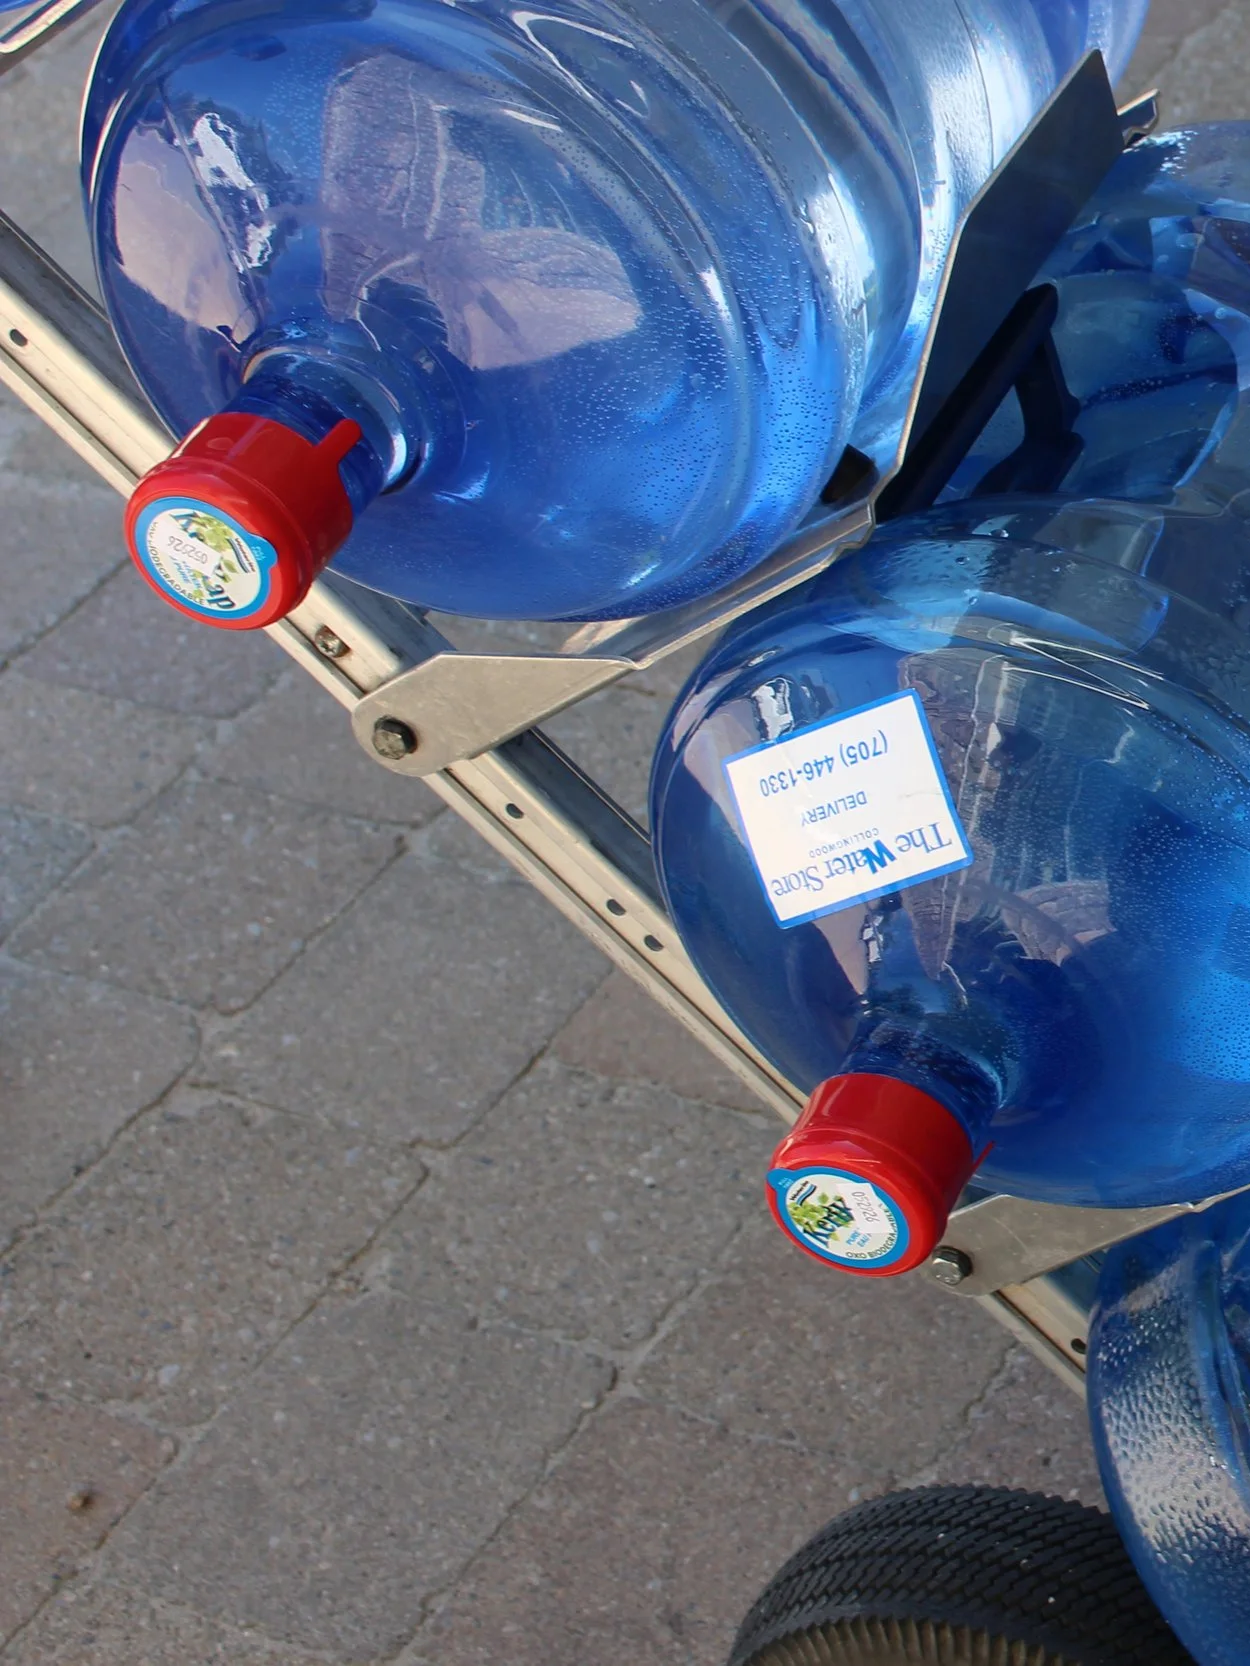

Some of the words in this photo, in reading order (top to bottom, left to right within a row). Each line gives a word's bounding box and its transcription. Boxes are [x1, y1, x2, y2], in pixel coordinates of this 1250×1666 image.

[839, 730, 888, 767] (705)
[759, 754, 835, 797] 446-1330
[800, 790, 867, 827] DELIVERY
[809, 827, 879, 858] COLLINGWOOD
[895, 822, 952, 855] The
[824, 839, 897, 879] Water
[770, 865, 825, 897] Store
